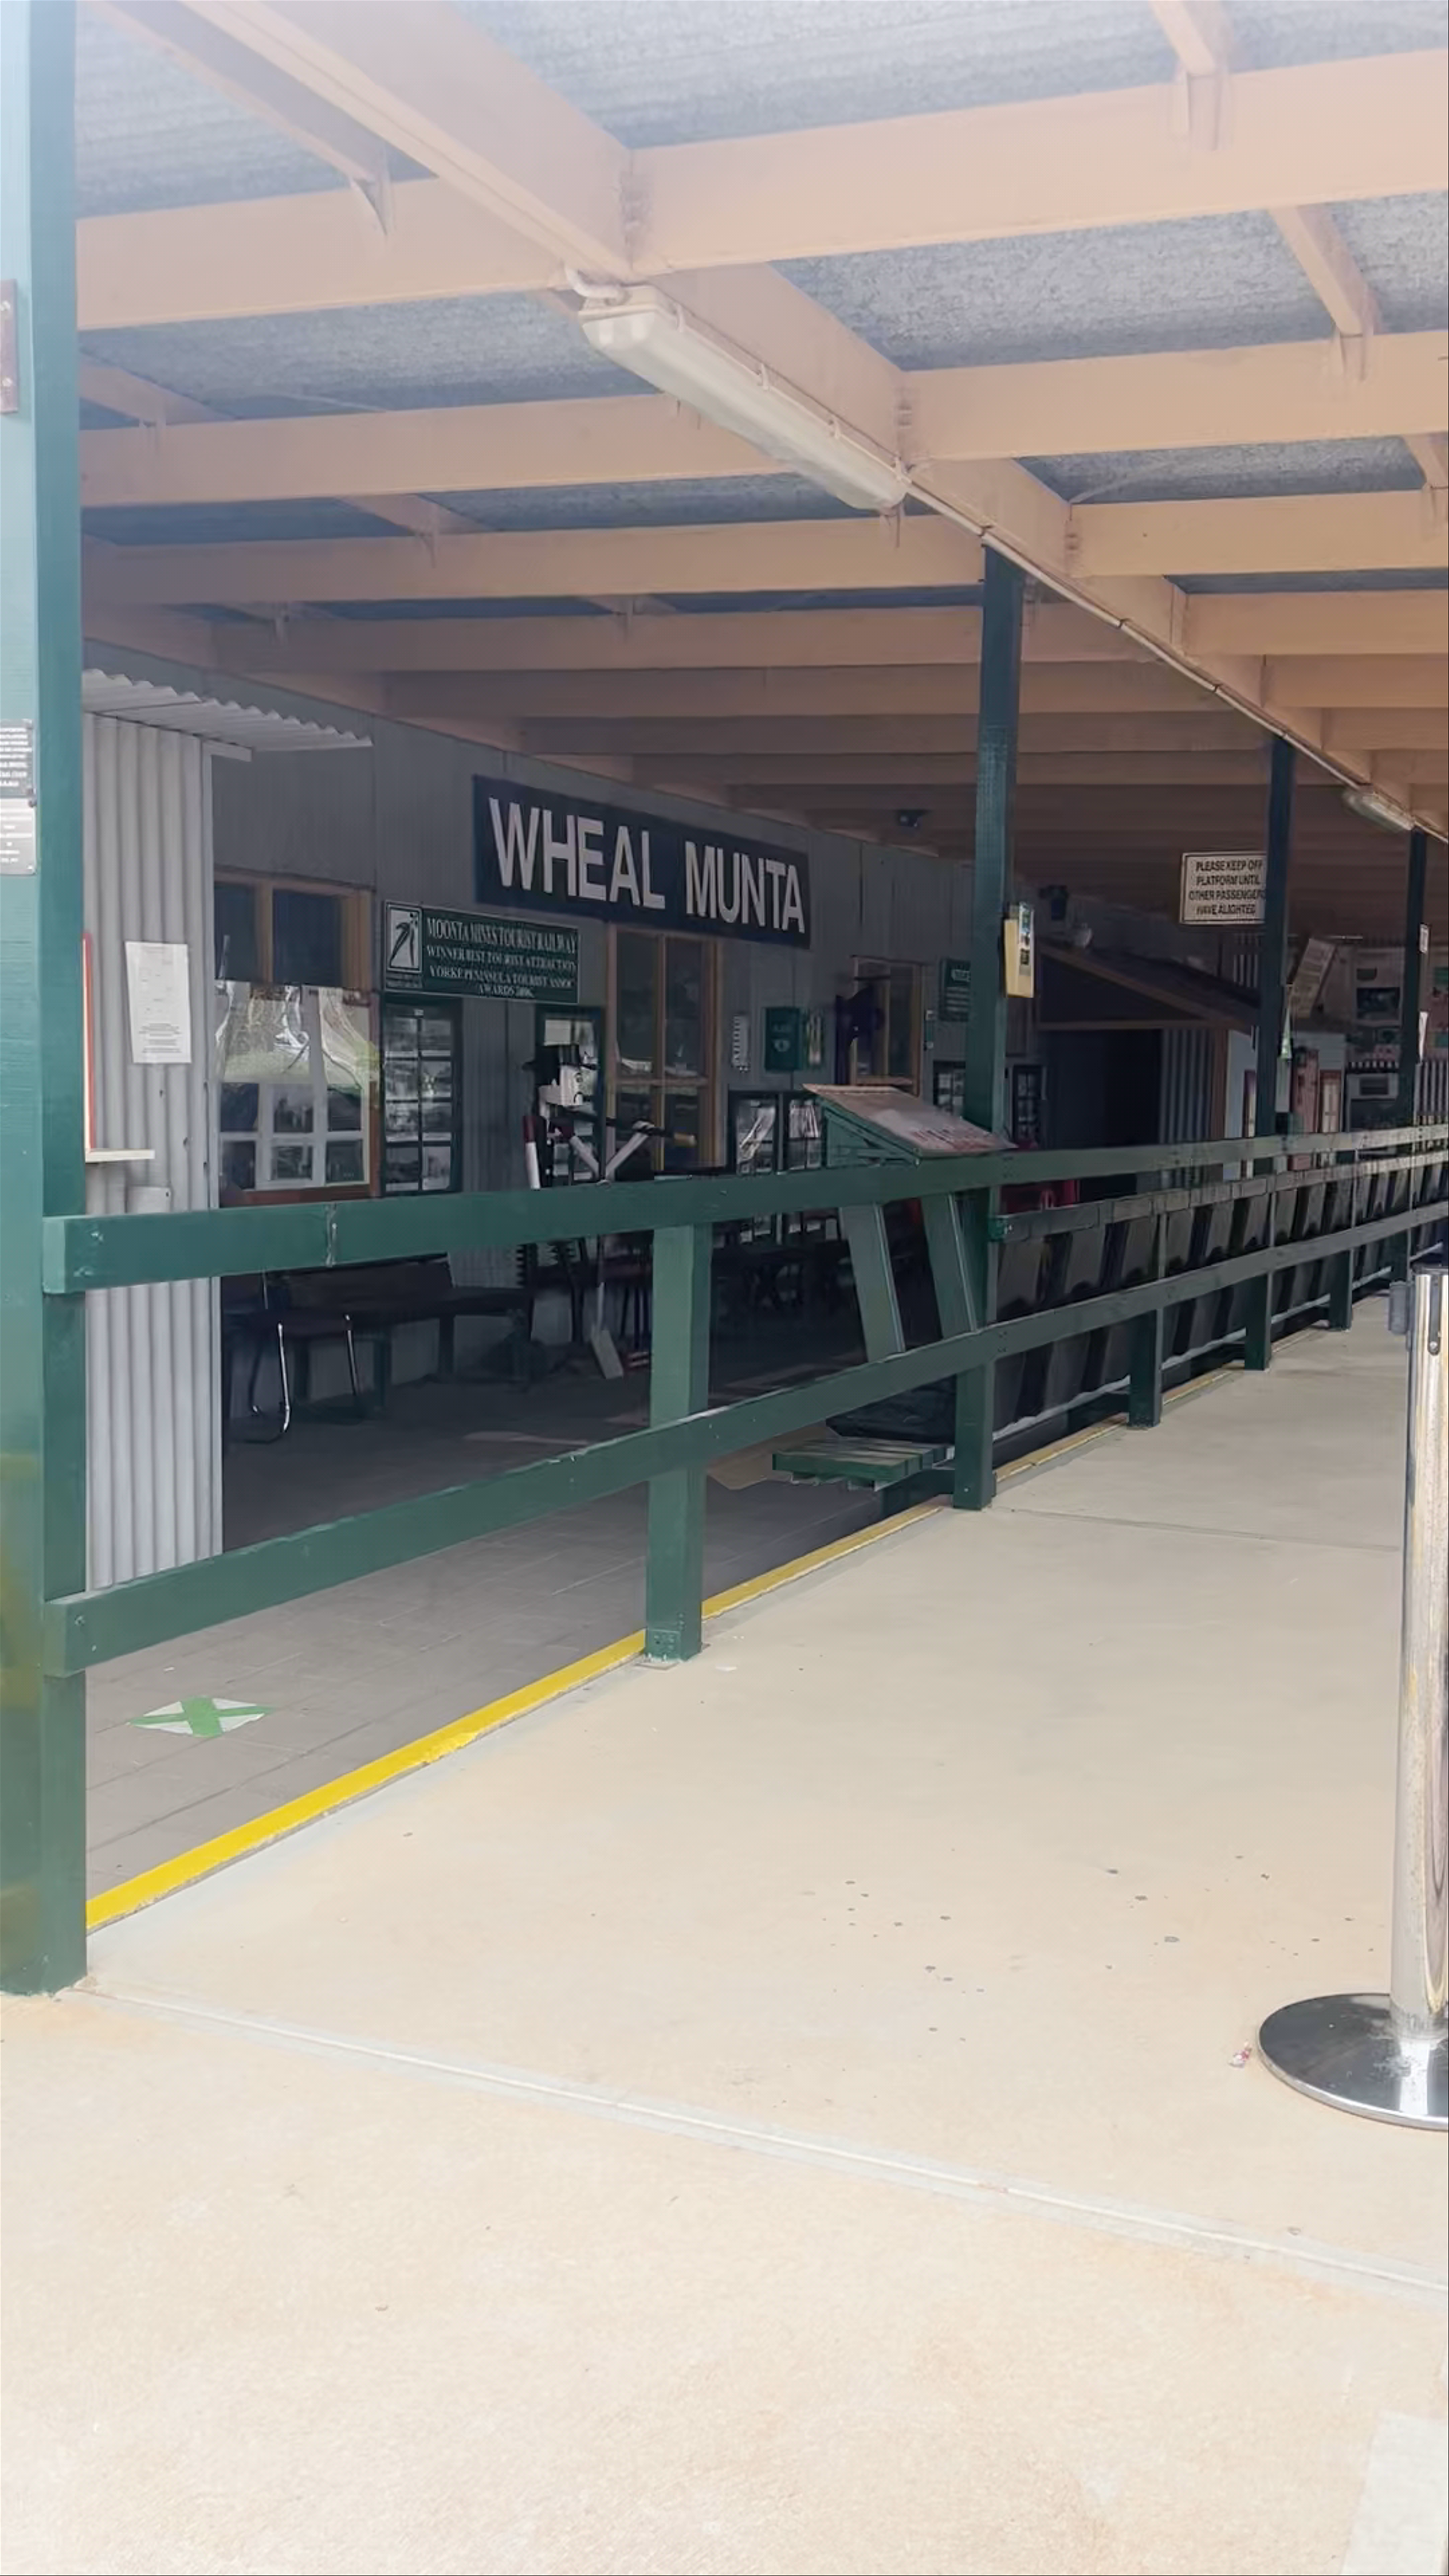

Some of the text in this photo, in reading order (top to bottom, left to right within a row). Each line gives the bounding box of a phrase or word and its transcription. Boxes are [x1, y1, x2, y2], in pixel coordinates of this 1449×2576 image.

[489, 797, 805, 934] WHEAL MUNTA
[1196, 859, 1263, 871] PLEASE KEEP OFF
[1196, 875, 1260, 885] PLATFORM UNTIL
[1189, 890, 1214, 900] OTHER
[1196, 904, 1255, 915] HAVE ALIGHTED
[427, 917, 576, 954] MOONTA MINES TOURIST RAILWAY
[427, 944, 576, 972] WINNER BEST TOURIST ATTRACTION
[429, 964, 463, 978] YORKE
[464, 968, 511, 984] PENINSULA
[512, 973, 548, 987] TOURIST
[478, 983, 515, 996] AWARDS
